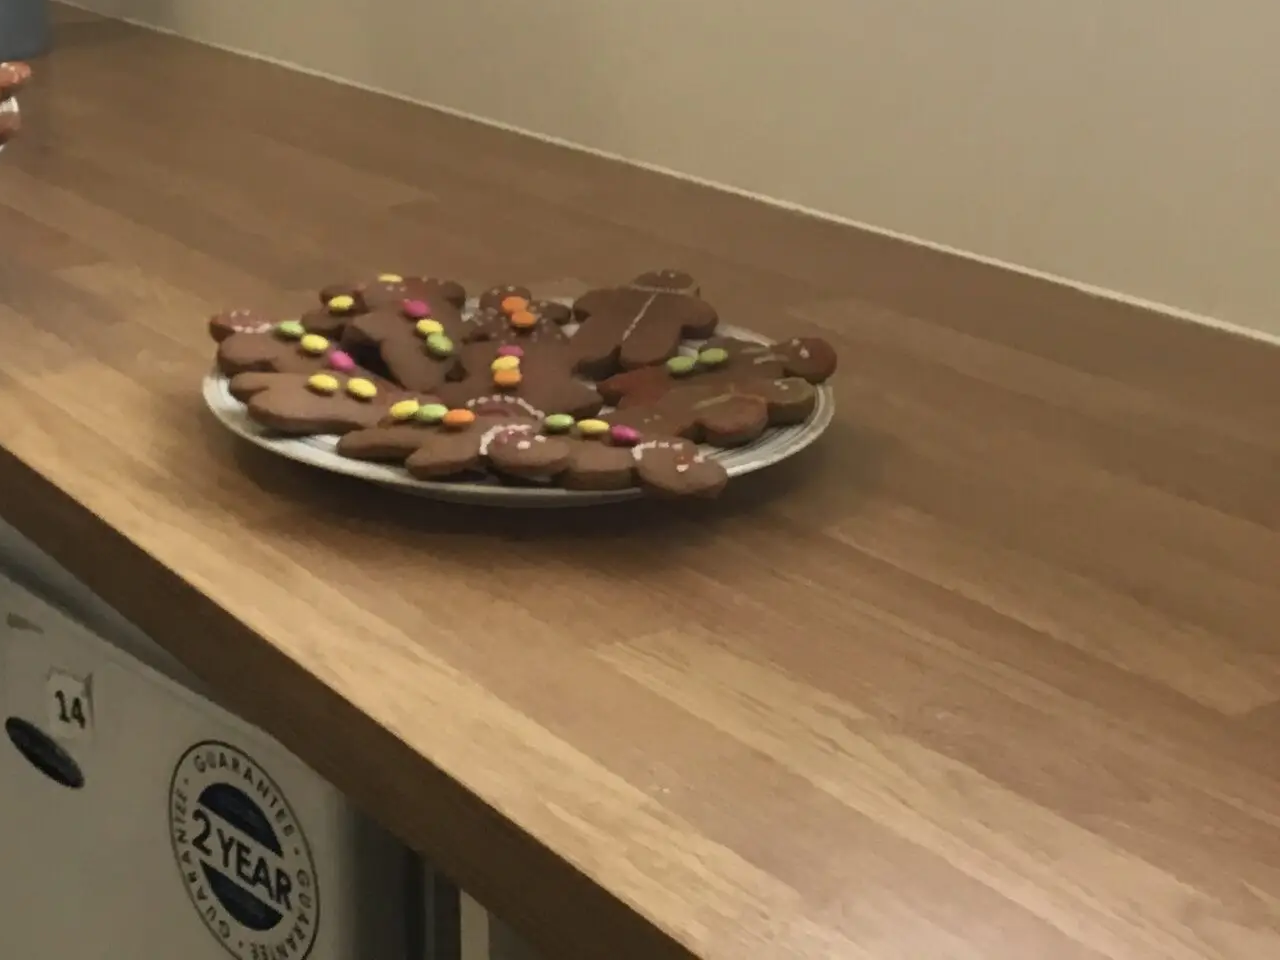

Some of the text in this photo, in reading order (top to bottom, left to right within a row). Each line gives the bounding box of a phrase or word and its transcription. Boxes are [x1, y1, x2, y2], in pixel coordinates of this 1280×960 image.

[55, 690, 86, 729] 14
[194, 752, 295, 838] GUARANTEE
[192, 808, 292, 911] 2 YEAR
